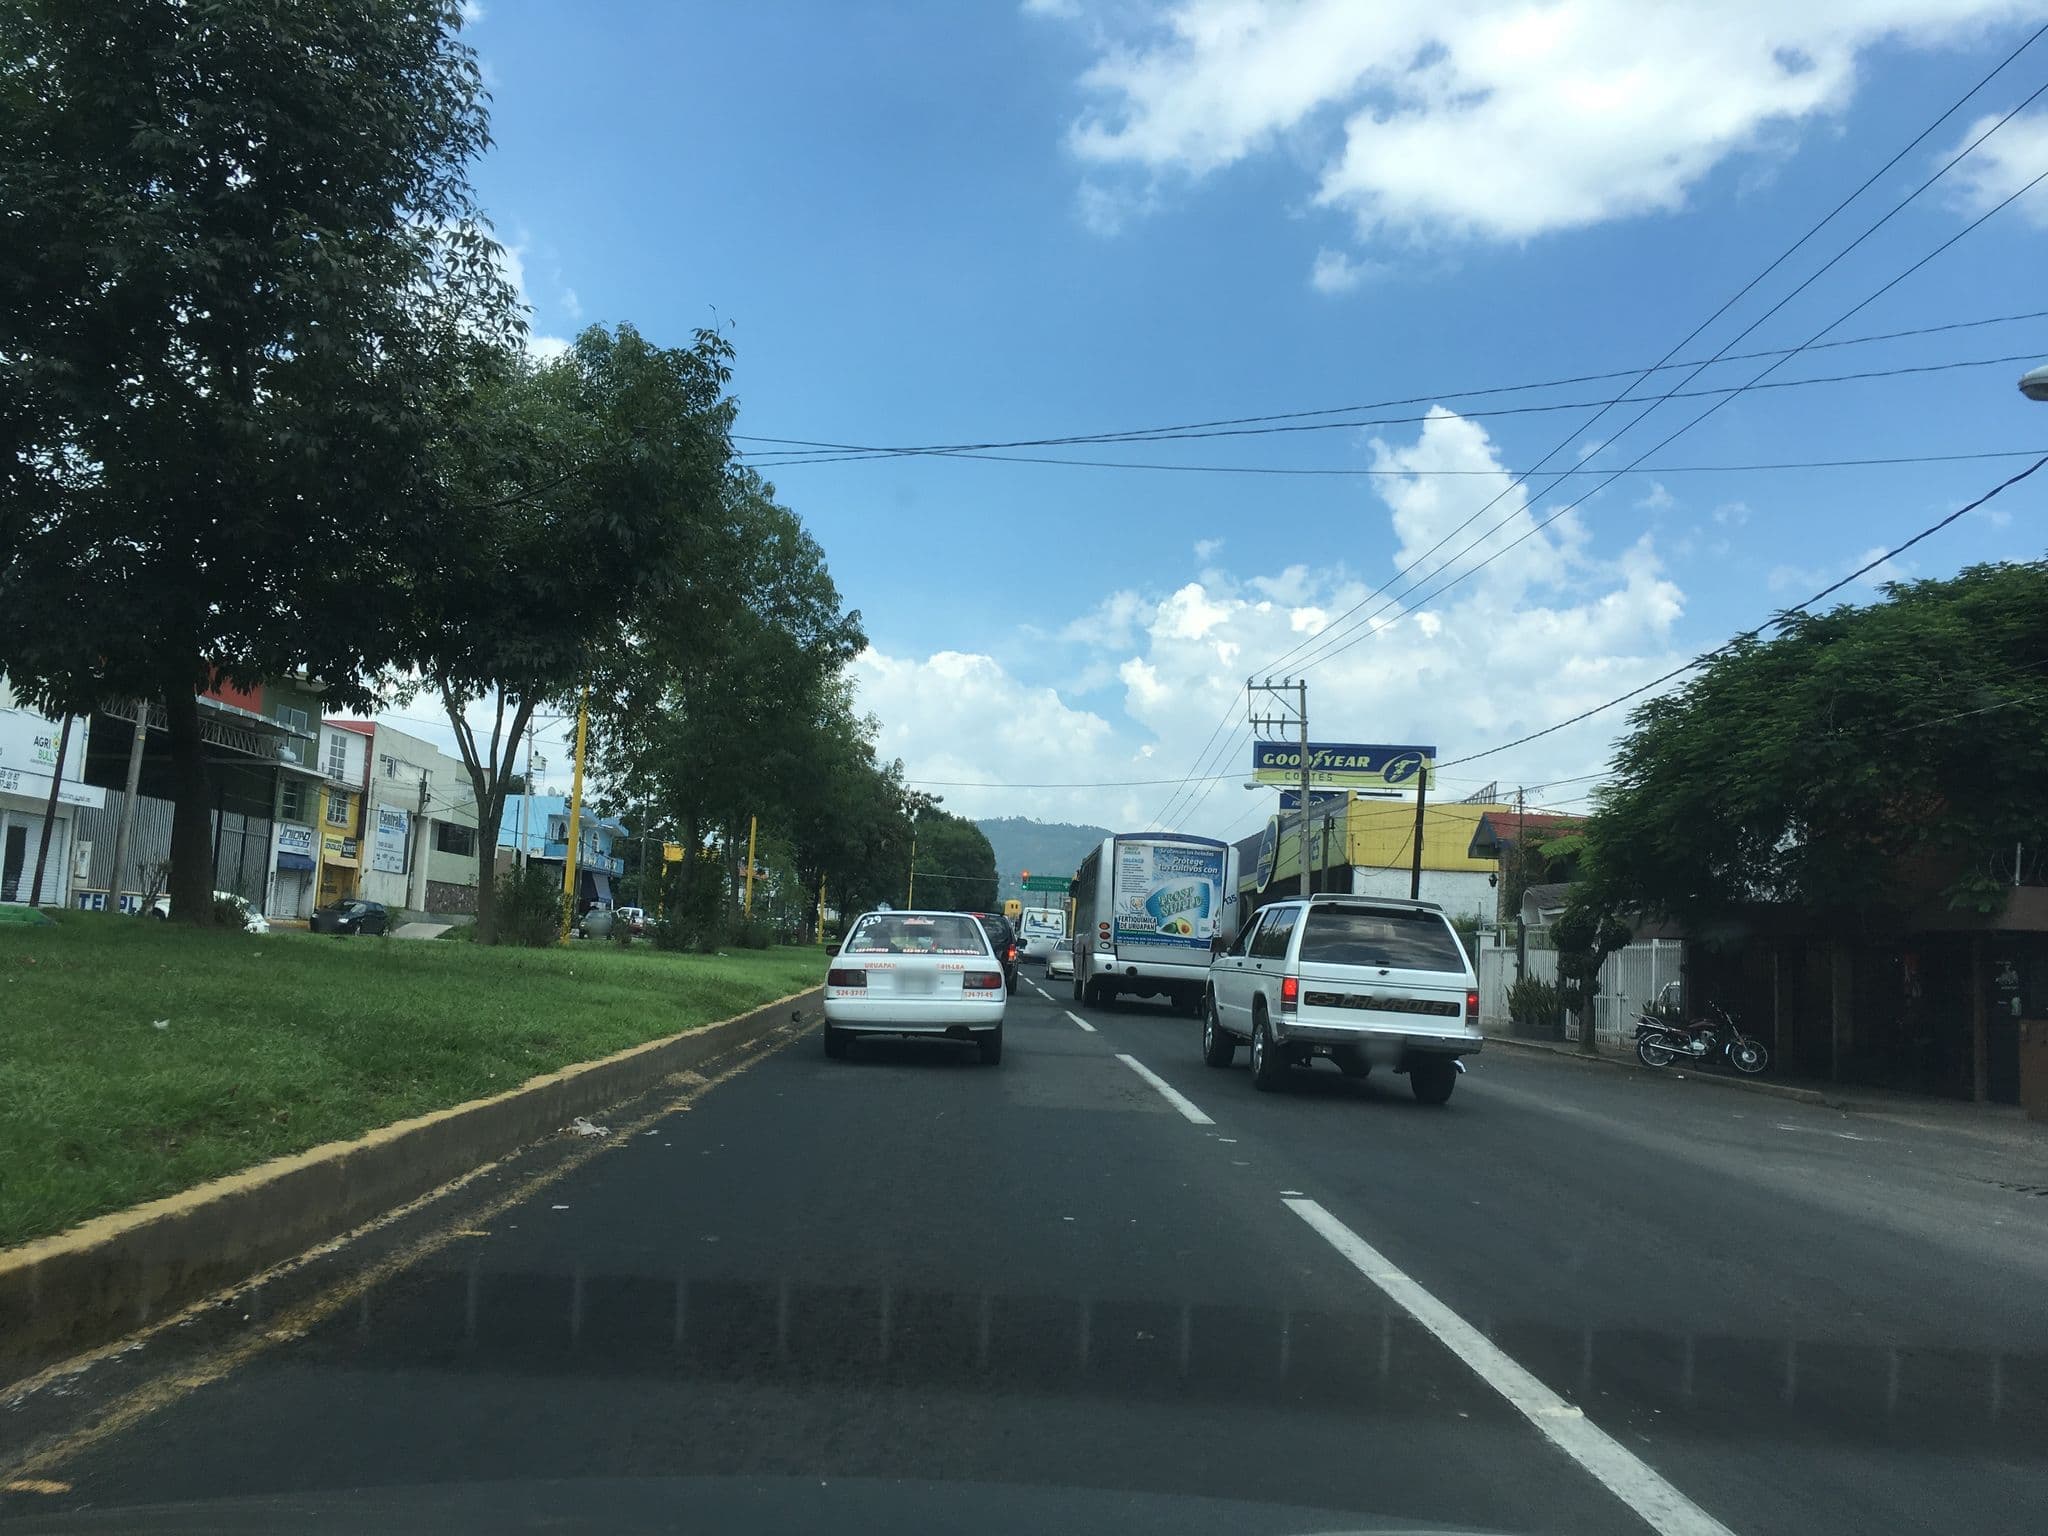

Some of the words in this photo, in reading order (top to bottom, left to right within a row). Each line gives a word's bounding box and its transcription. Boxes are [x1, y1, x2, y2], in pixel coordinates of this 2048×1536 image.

[33, 735, 51, 749] AGRI
[1284, 772, 1333, 782] COTES
[1173, 856, 1204, 866] Protege
[1171, 864, 1202, 873] cultivos
[1203, 866, 1218, 874] con
[1224, 894, 1238, 906] 135
[862, 915, 881, 928] 229
[1340, 995, 1459, 1015] CHEVROLET
